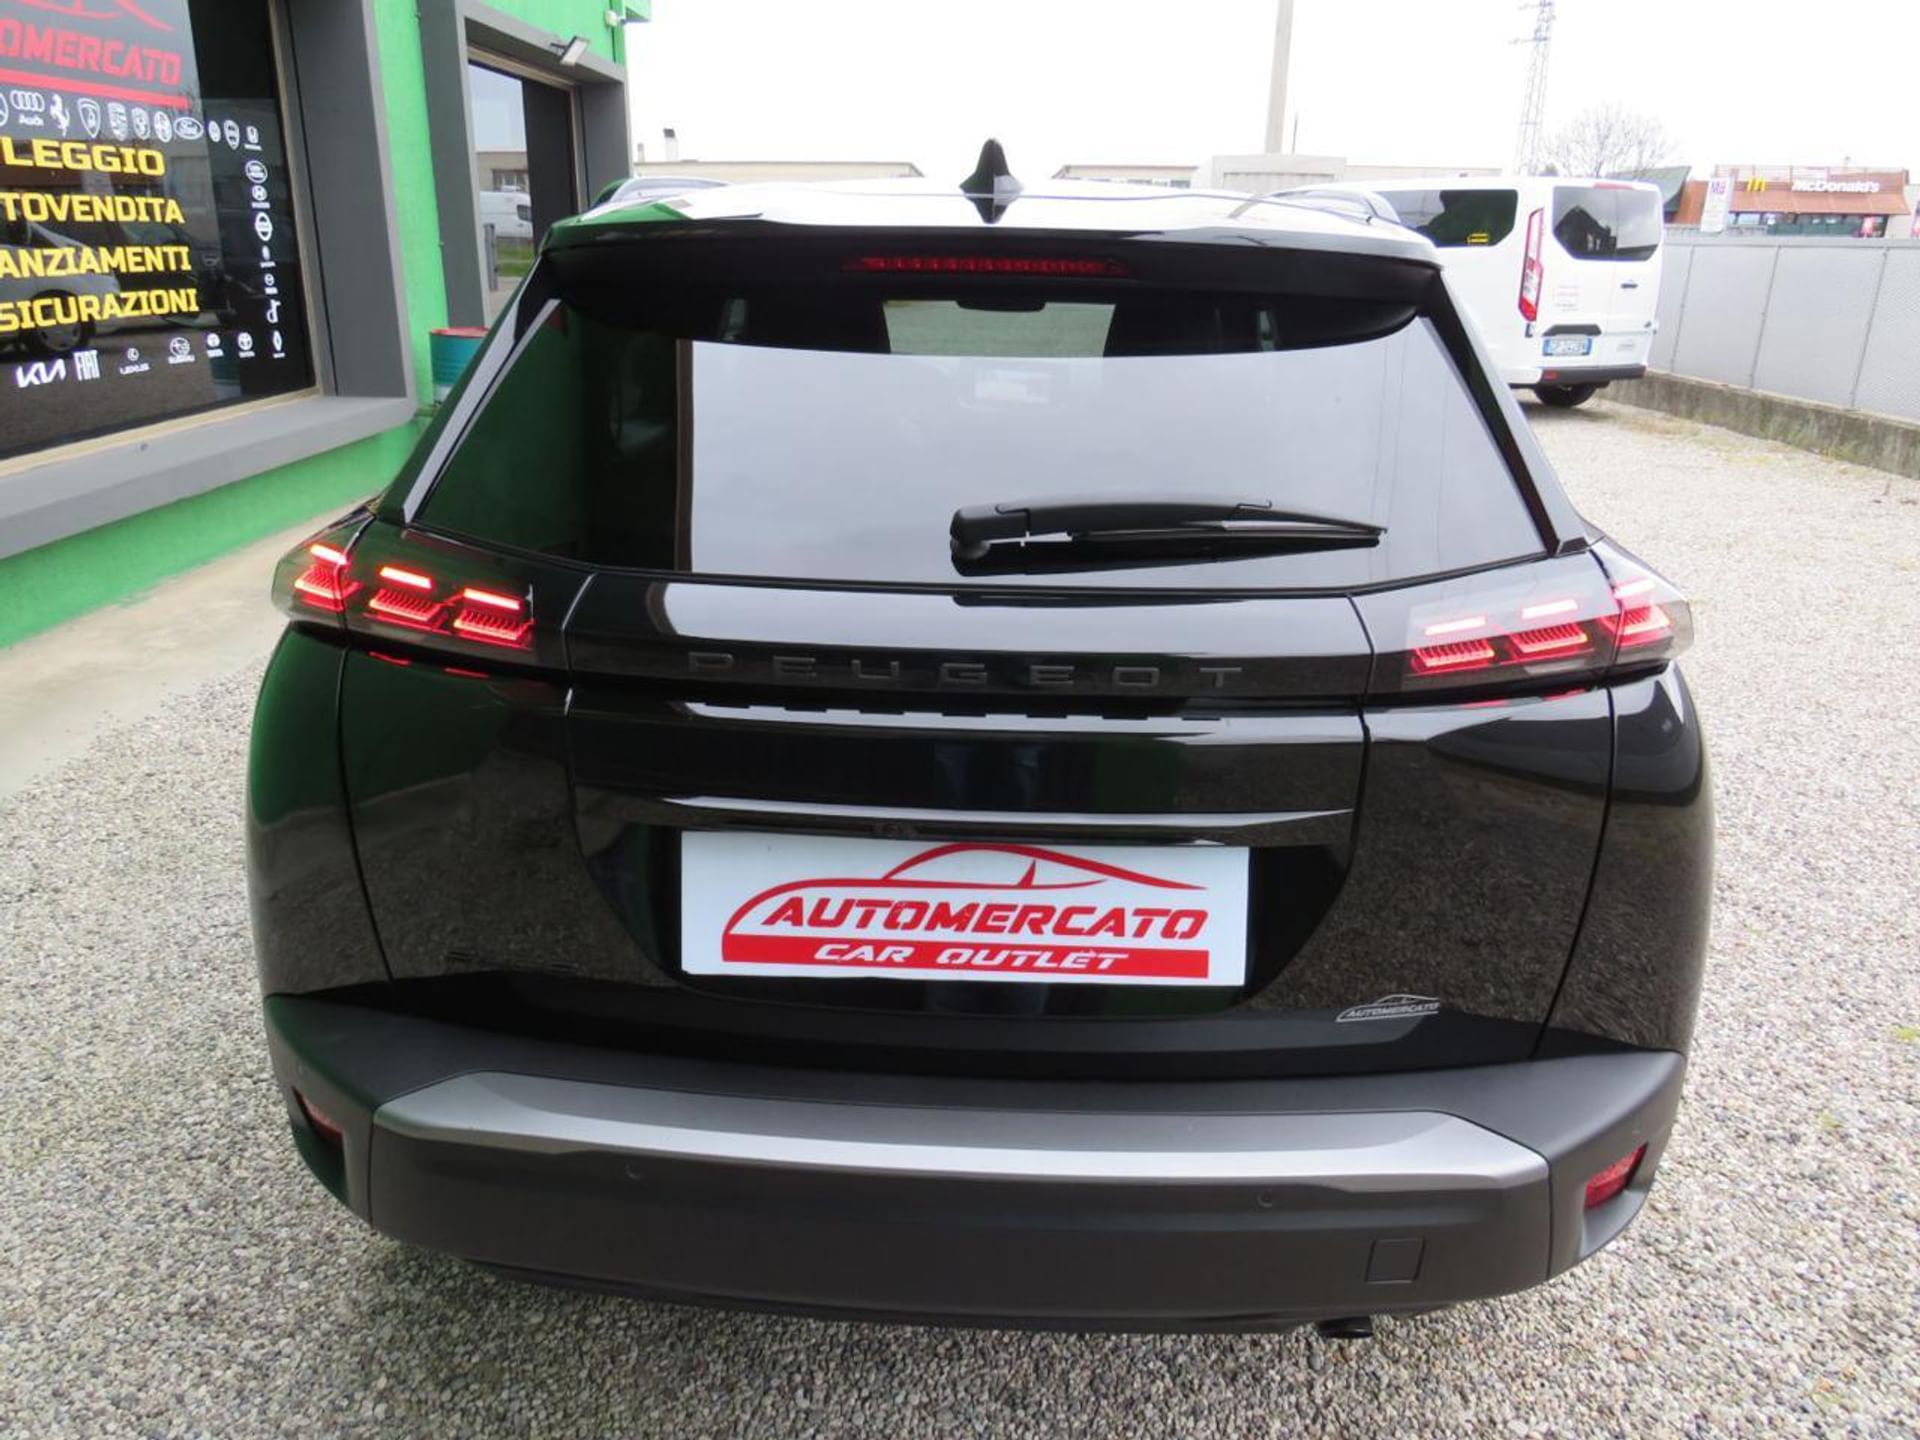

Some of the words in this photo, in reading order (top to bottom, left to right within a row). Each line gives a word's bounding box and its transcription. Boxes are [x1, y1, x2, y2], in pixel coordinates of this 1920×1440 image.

[1791, 179, 1880, 194] McDonald's
[74, 350, 100, 381] FIAT
[688, 650, 1243, 690] PEUGEOT
[761, 896, 1208, 941] AUTOMERCATO
[813, 943, 921, 965] CAR
[935, 947, 1130, 971] OUTLET
[1347, 1002, 1441, 1018] AUTOMERCATO
